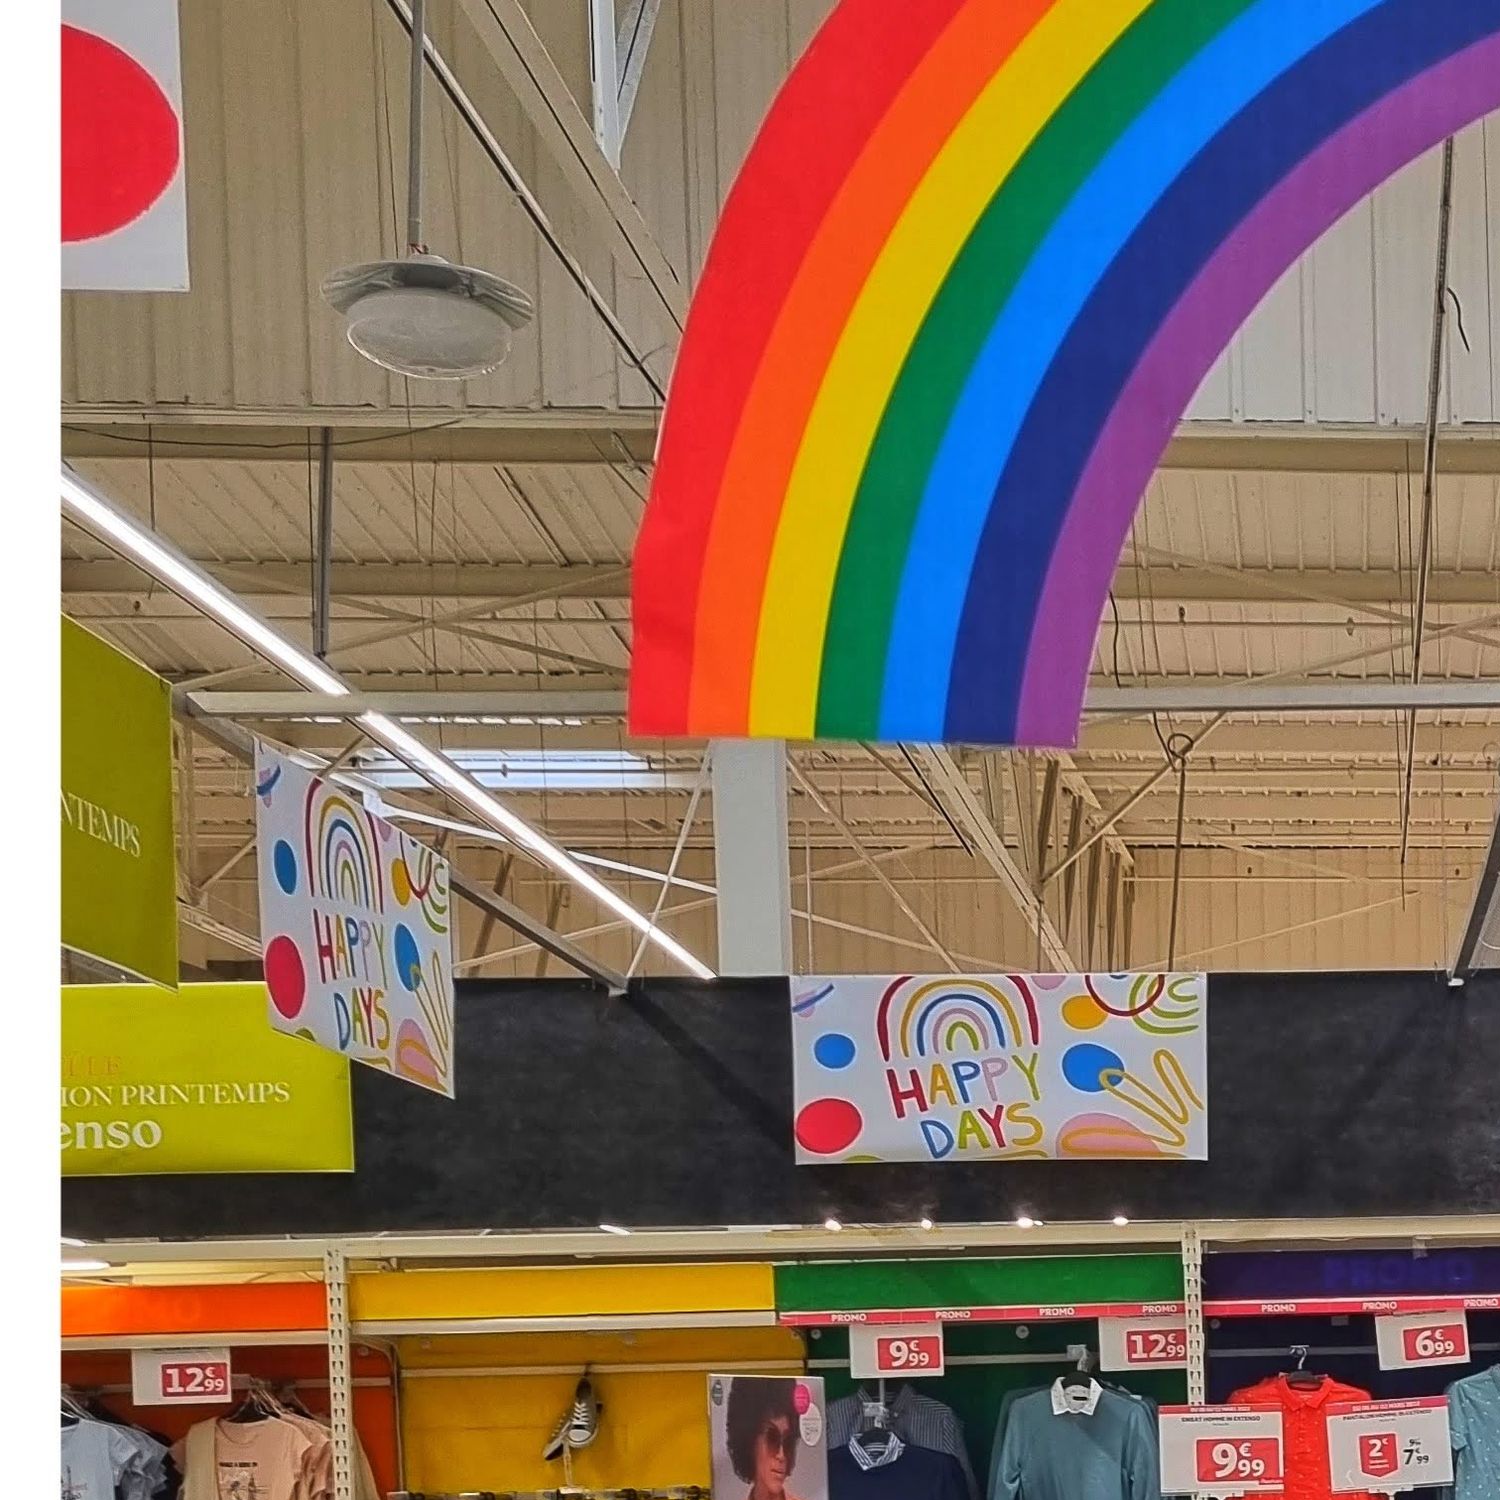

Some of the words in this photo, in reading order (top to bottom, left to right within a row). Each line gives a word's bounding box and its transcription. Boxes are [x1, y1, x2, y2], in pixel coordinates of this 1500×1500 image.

[313, 909, 388, 987] HAPPY
[334, 986, 391, 1051] DAYS
[885, 1054, 1042, 1119] HAPPY
[122, 1082, 291, 1106] PRINTEMPS
[920, 1102, 1044, 1159] DAYS
[1362, 1301, 1397, 1310] PROMO
[1464, 1298, 1499, 1307] PROMO
[1039, 1307, 1075, 1316] PROMO
[1142, 1304, 1178, 1313] PROMO
[1261, 1303, 1296, 1312] PROMO
[831, 1313, 867, 1322] PROMO
[935, 1310, 971, 1319] PROMO
